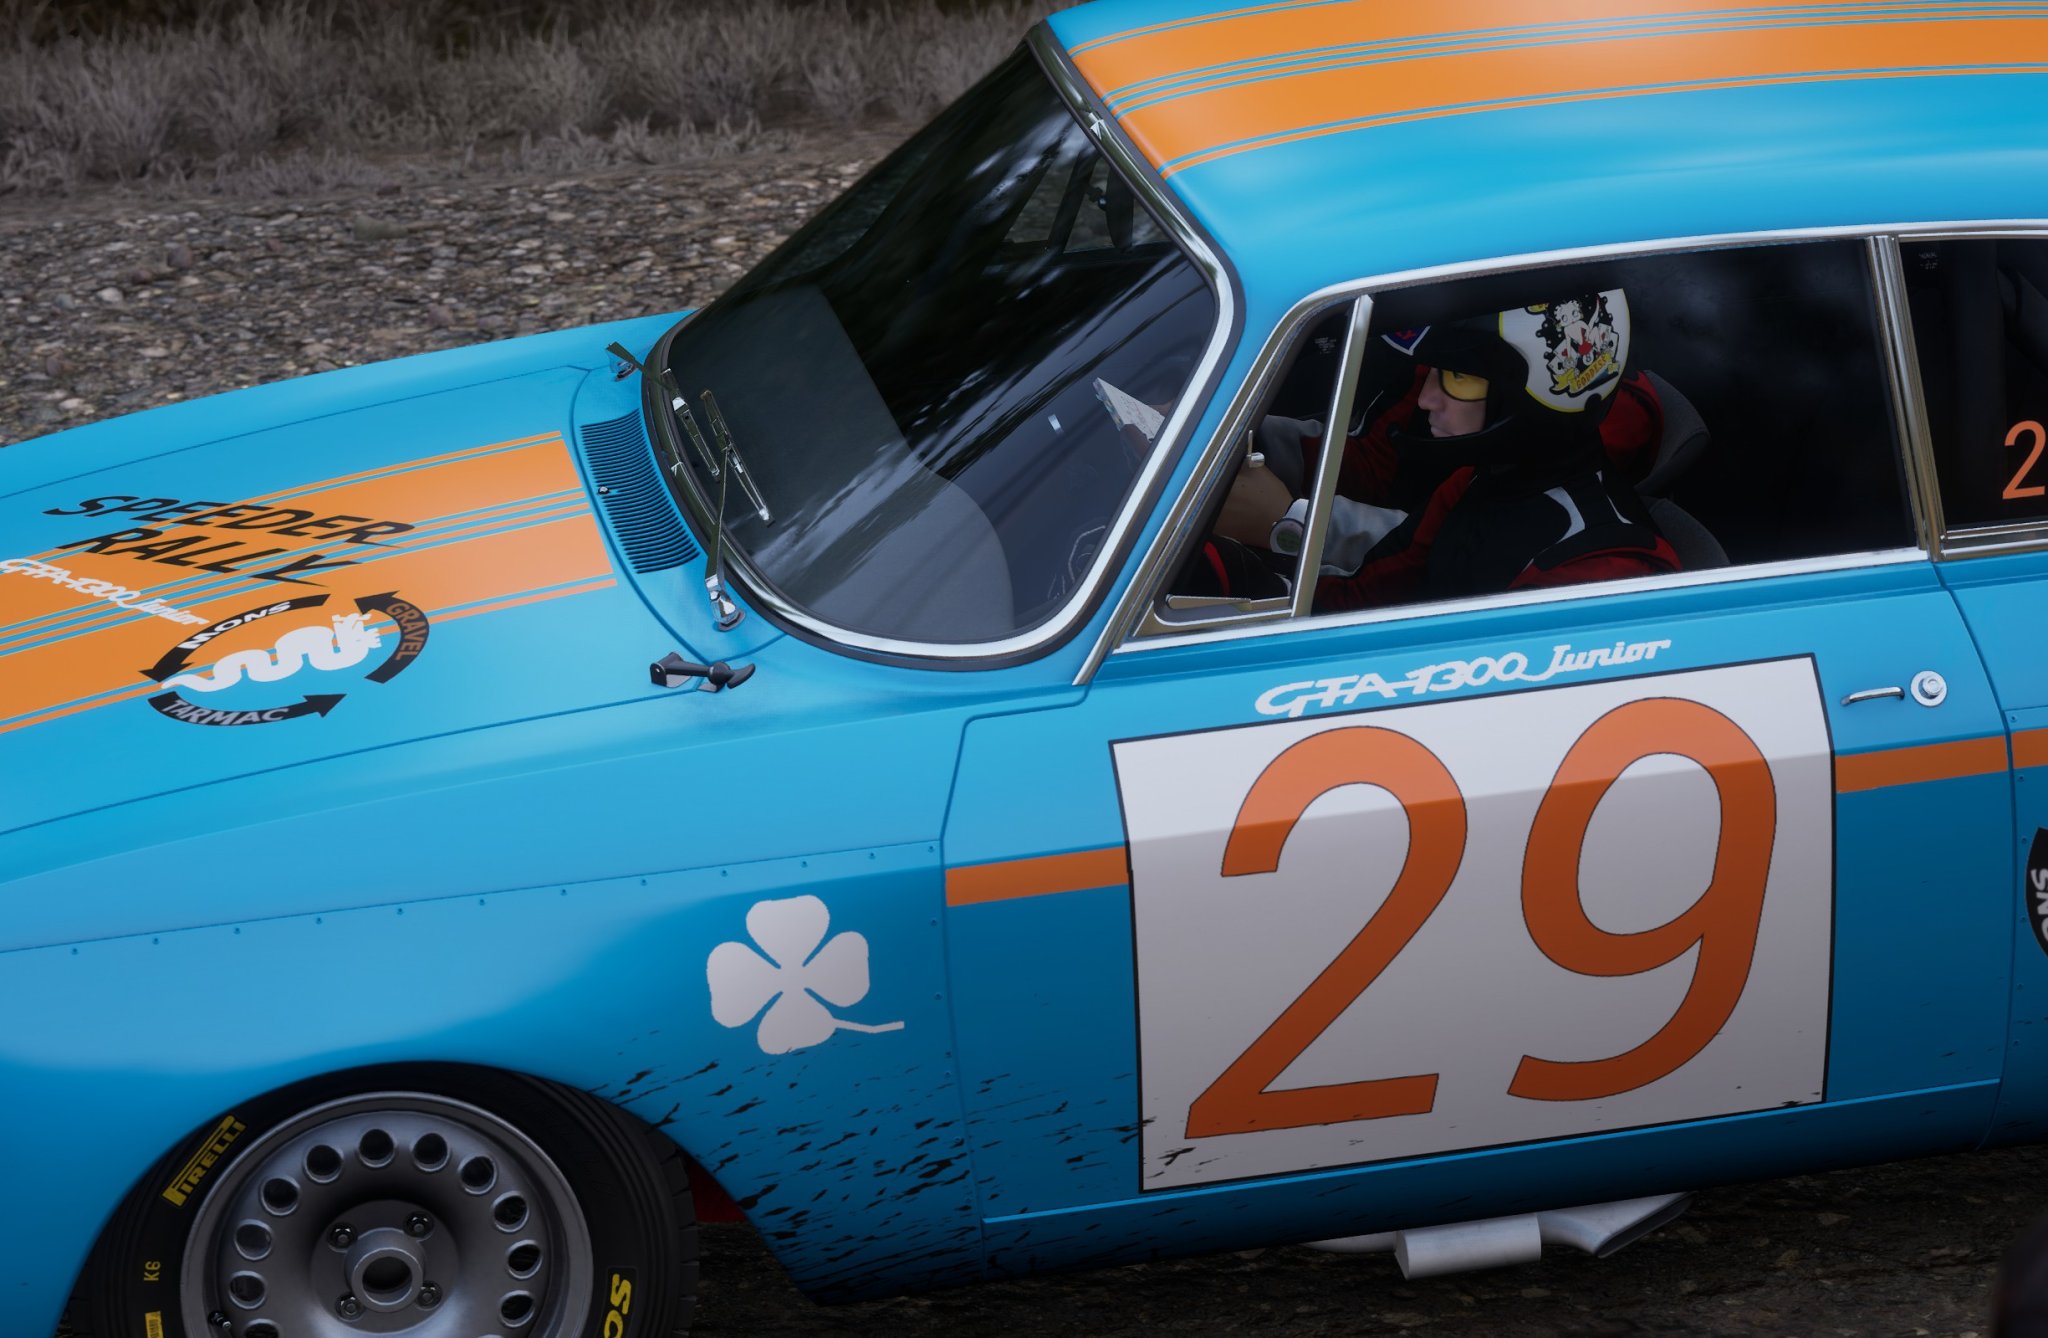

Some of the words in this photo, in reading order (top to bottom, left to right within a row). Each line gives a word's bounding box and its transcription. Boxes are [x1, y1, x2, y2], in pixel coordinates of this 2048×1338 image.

[2002, 420, 2047, 500] 2
[42, 496, 415, 549] SPEEDER
[55, 528, 363, 587] RALLY
[117, 598, 210, 625] Junior
[385, 603, 426, 661] GRAVEL
[1515, 639, 1672, 682] Junior
[162, 699, 290, 726] TARMAC
[1184, 697, 1777, 1140] 29
[162, 1115, 246, 1207] PIRELLI
[143, 1260, 162, 1281] K6
